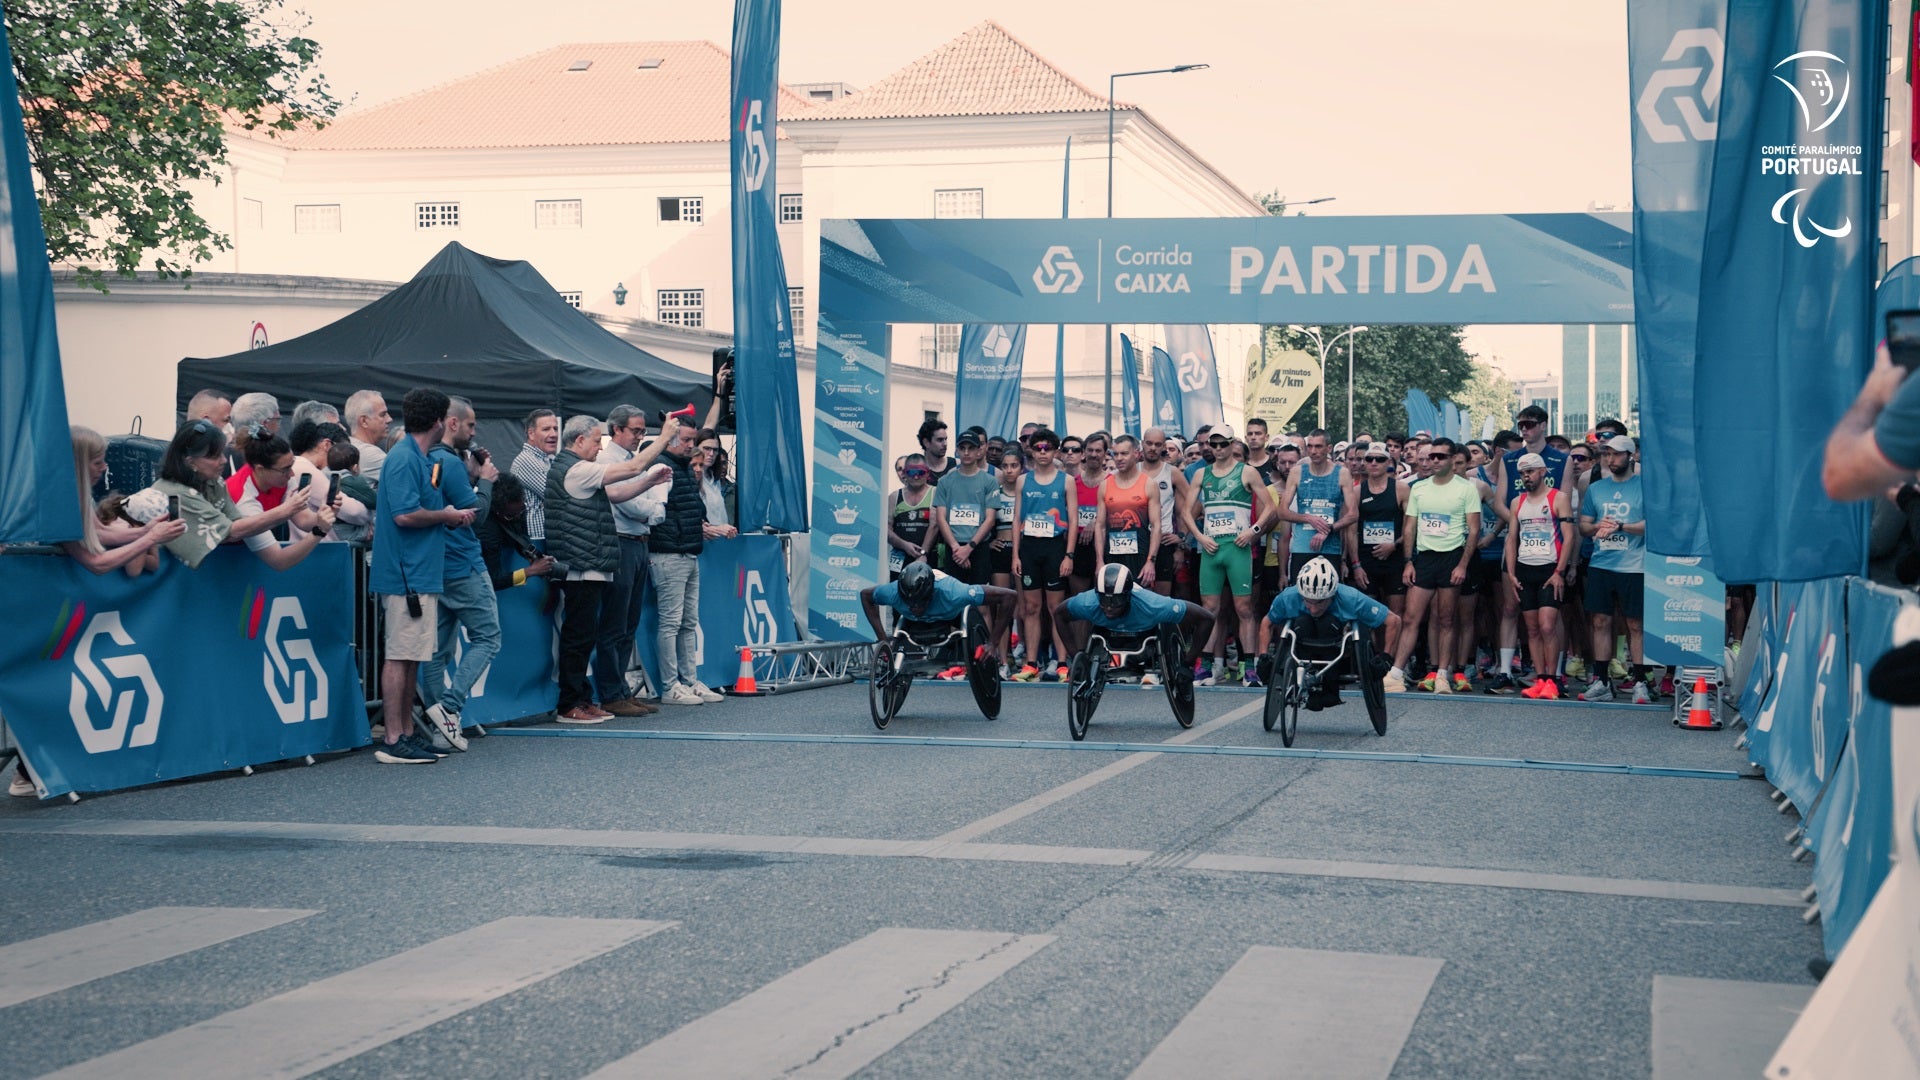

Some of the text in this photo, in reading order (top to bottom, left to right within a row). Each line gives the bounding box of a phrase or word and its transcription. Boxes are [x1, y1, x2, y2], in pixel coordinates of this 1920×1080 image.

[1115, 243, 1192, 266] Corrida
[1229, 243, 1497, 295] PARTIDA
[1115, 273, 1191, 293] CAIXA
[1269, 368, 1281, 386] 4
[1282, 368, 1312, 377] minutos
[1281, 375, 1304, 388] /km
[830, 484, 863, 494] YoPRO
[954, 510, 976, 518] 2261
[1602, 502, 1630, 518] 150
[1031, 520, 1048, 529] 1811
[1210, 518, 1233, 528] 2835
[1426, 519, 1442, 528] 261
[1366, 528, 1392, 537] 2494
[1112, 538, 1133, 547] 1547
[1524, 539, 1546, 547] 3016
[828, 556, 861, 567] CEFAD
[1665, 574, 1704, 586] CEFAD
[825, 611, 858, 621] POWER
[1664, 634, 1702, 644] POWER
